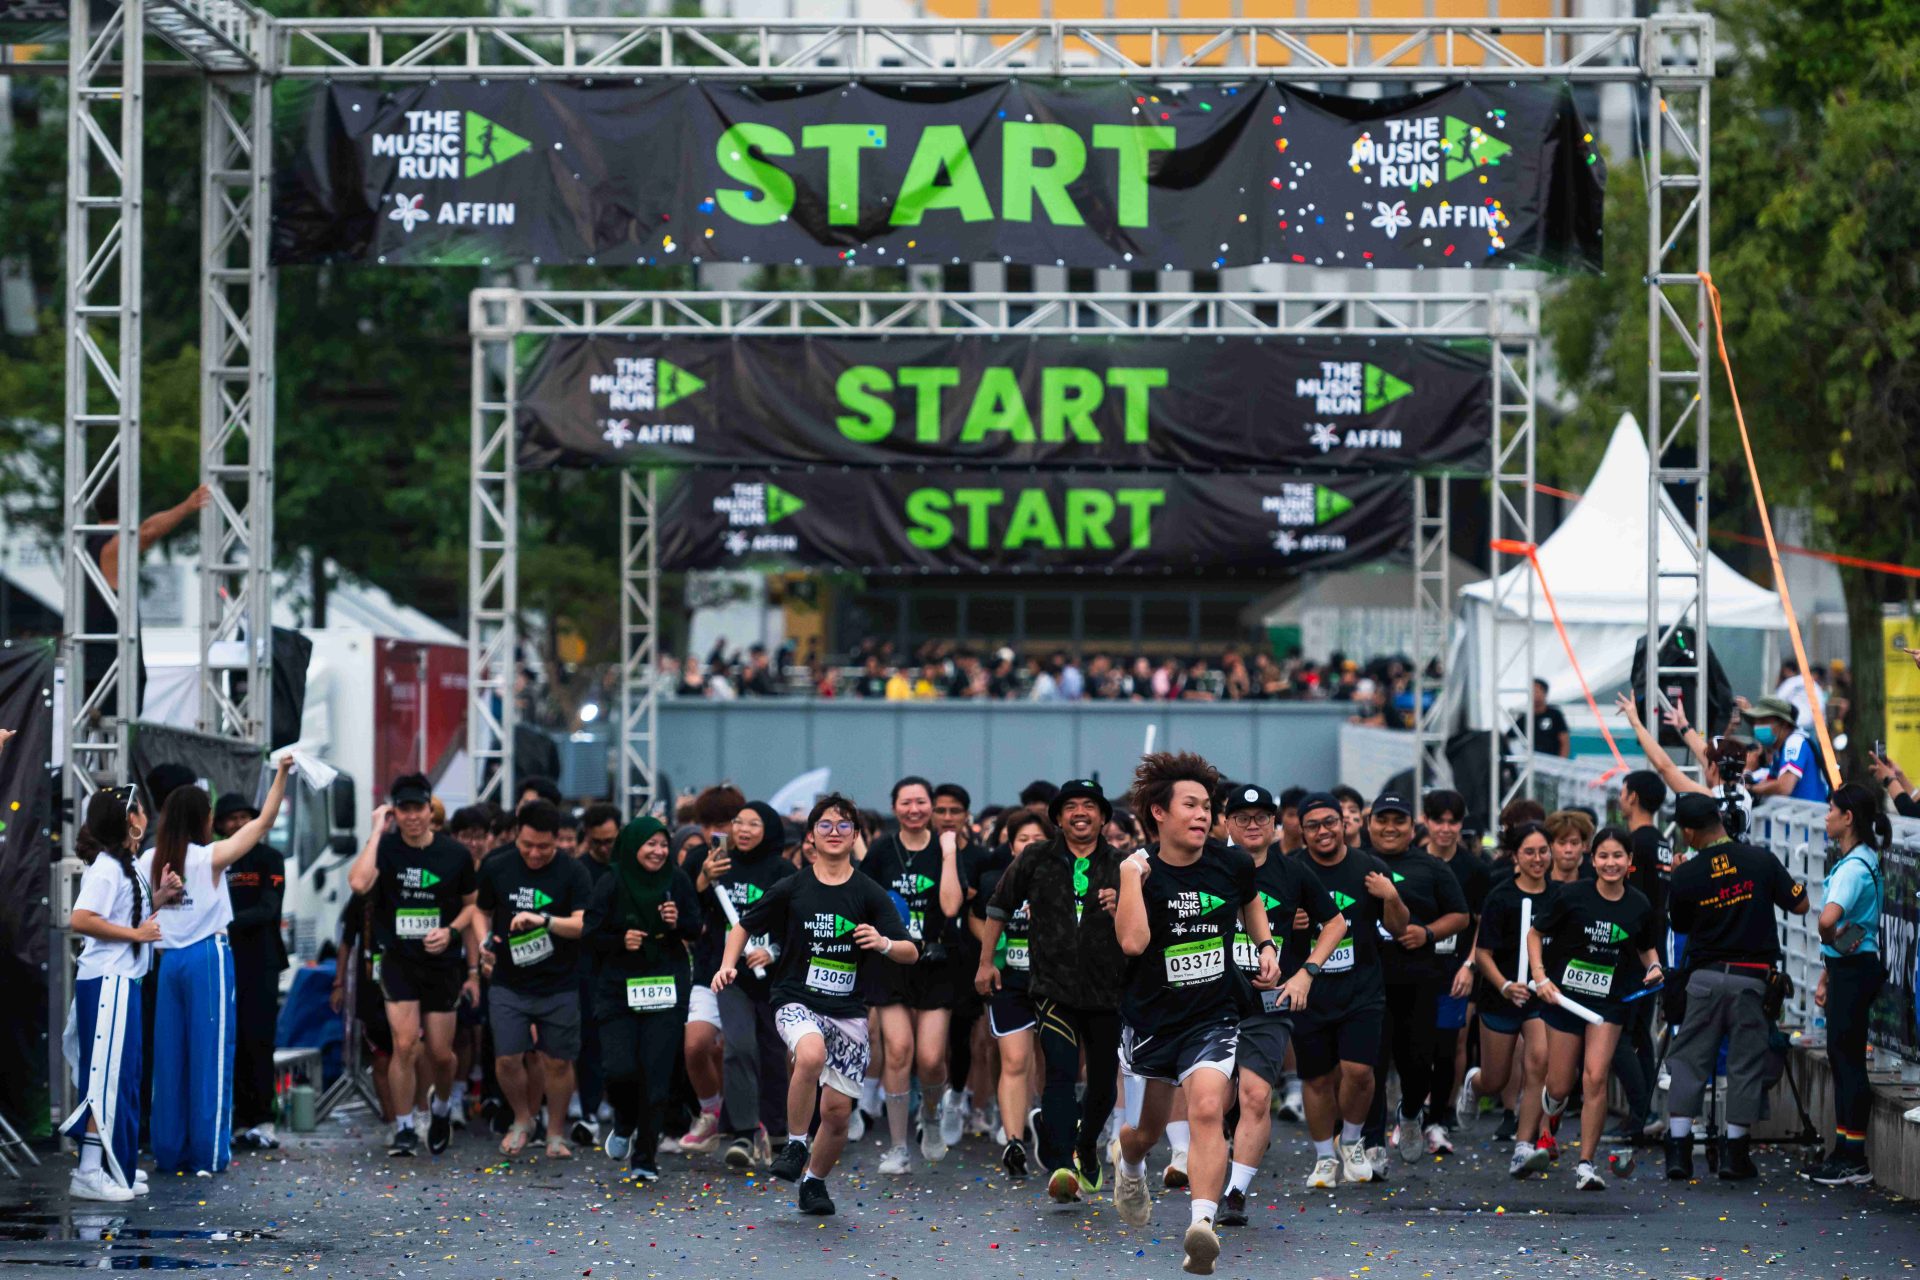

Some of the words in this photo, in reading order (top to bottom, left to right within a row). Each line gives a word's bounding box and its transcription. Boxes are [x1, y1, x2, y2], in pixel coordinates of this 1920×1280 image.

[405, 110, 460, 132] THE
[1384, 117, 1440, 141] THE
[372, 133, 460, 156] MUSIC
[1351, 138, 1440, 166] MUSIC
[399, 156, 460, 179] RUN
[715, 122, 1177, 228] START
[1380, 162, 1440, 187] RUN
[437, 202, 515, 225] AFFIN
[1419, 205, 1497, 228] AFFIN
[614, 358, 656, 374] THE
[1320, 362, 1362, 378] THE
[590, 374, 656, 393] MUSIC
[1296, 378, 1362, 397] MUSIC
[609, 392, 656, 411] RUN
[835, 365, 1168, 443] START
[1316, 396, 1362, 414] RUN
[637, 425, 695, 443] AFFIN
[1344, 430, 1402, 448] AFFIN
[905, 488, 1166, 549] START
[406, 868, 422, 876] THE
[519, 887, 534, 895] THE
[892, 880, 917, 888] MUSC
[509, 893, 533, 902] MUSIC
[516, 901, 533, 909] RUN
[1168, 900, 1201, 910] MUSIC
[1178, 892, 1199, 901] THE
[815, 914, 834, 922] THE
[1179, 909, 1201, 918] RUN
[804, 922, 834, 930] MUSIC
[1190, 924, 1219, 933] AFFIN
[1584, 926, 1611, 937] MUSIC
[1595, 920, 1611, 929] THE
[813, 930, 834, 938] RUN
[1591, 935, 1610, 944] RUN
[827, 945, 851, 953] AFFIN
[1170, 950, 1221, 972] 03372
[813, 968, 853, 985] 13050
[1567, 969, 1609, 987] 06785
[632, 986, 671, 999] 11879
